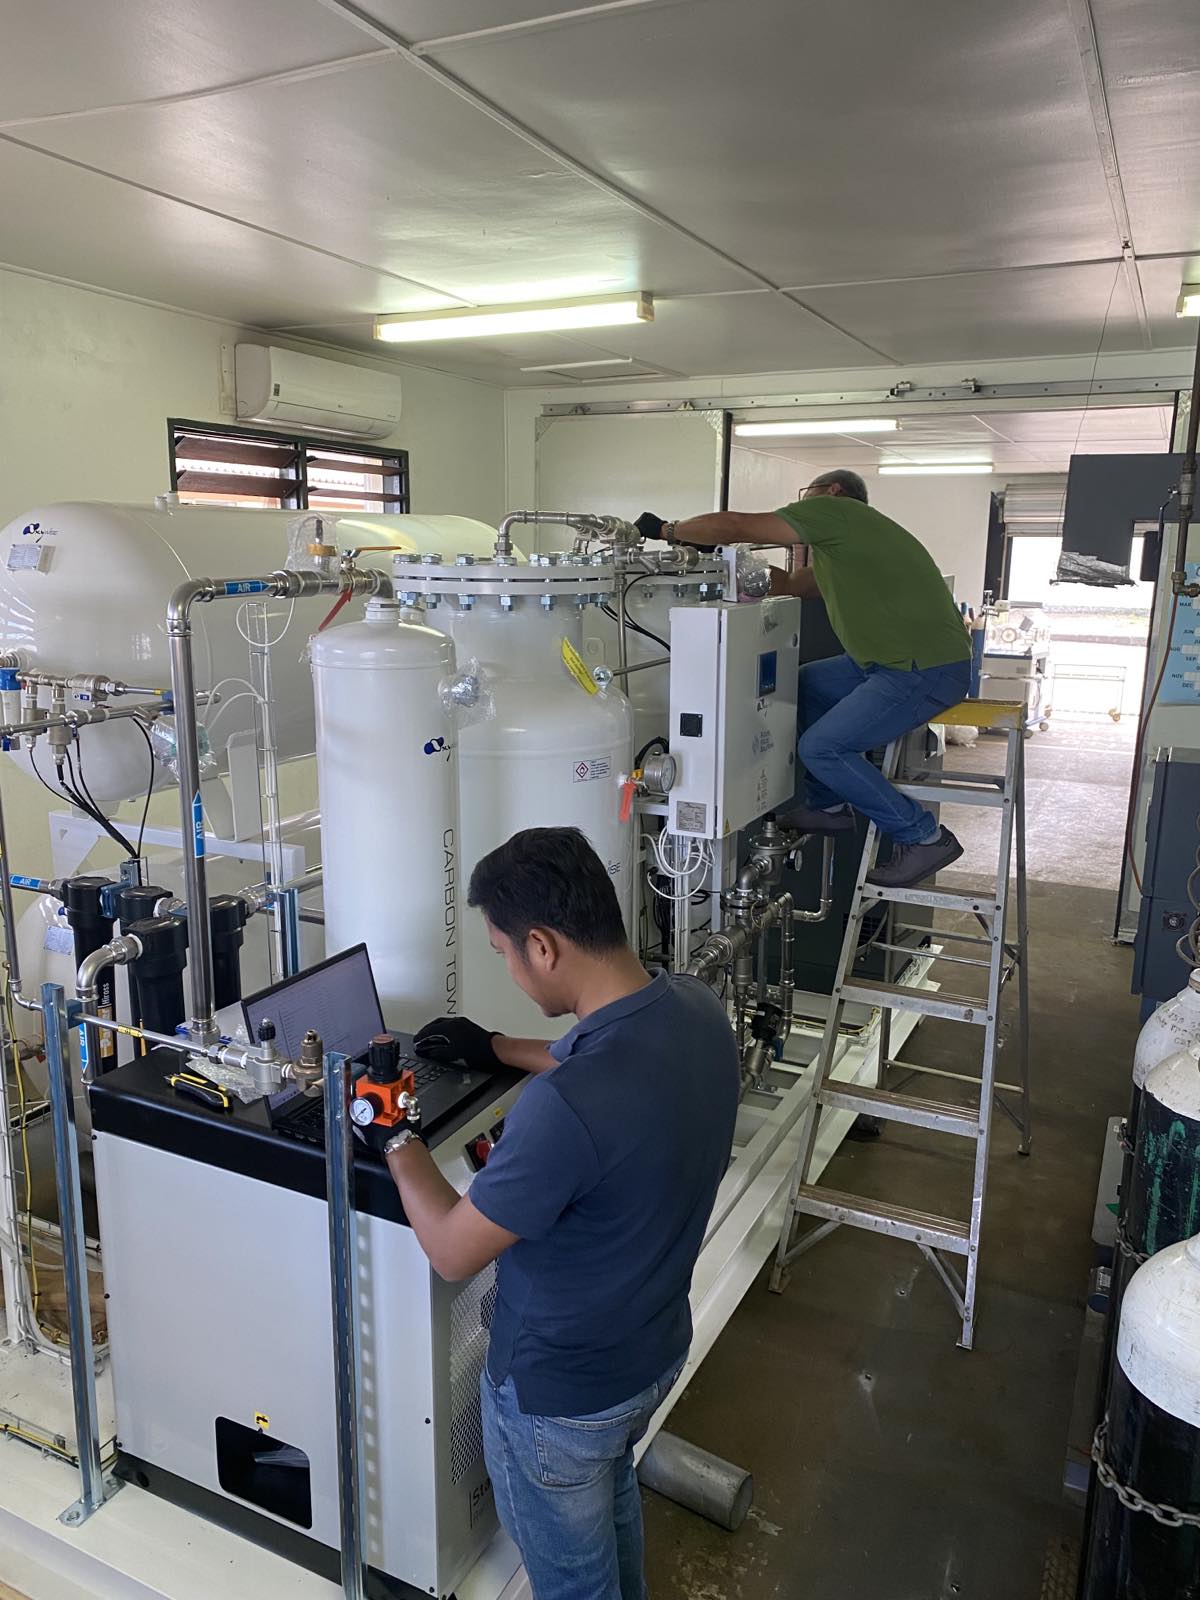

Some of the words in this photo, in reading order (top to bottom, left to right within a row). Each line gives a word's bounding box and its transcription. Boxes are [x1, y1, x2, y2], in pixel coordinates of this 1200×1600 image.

[237, 583, 251, 593] AIR
[195, 821, 204, 840] AIR
[20, 877, 32, 887] AIR
[443, 829, 456, 948] CARBON
[102, 982, 110, 1005] Hiross
[446, 954, 457, 1016] TOW
